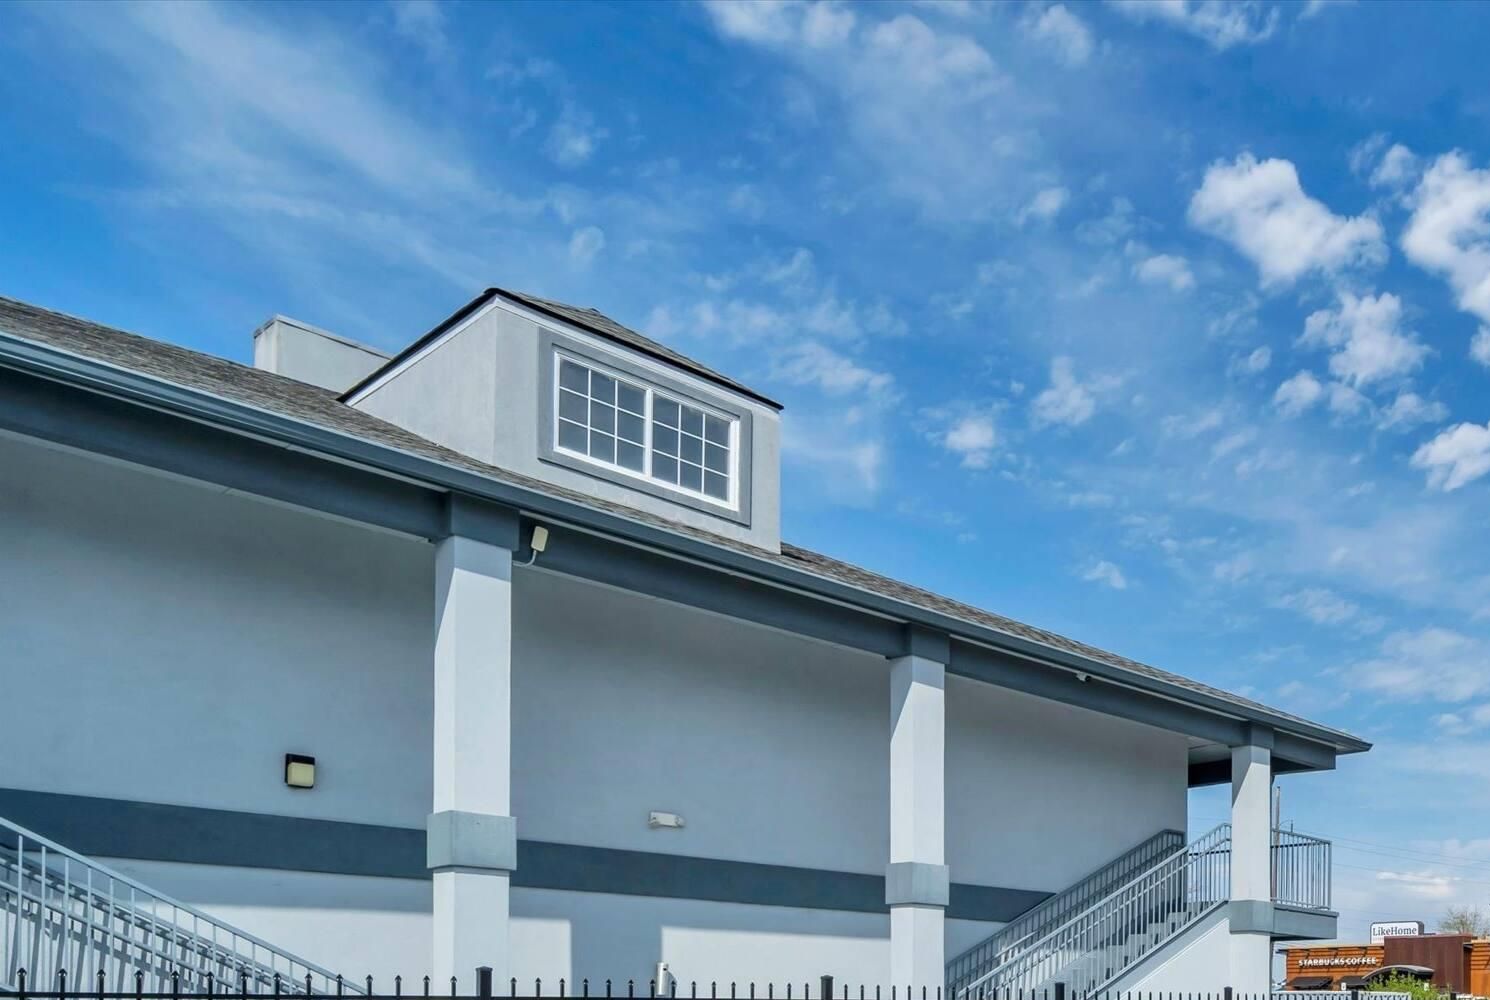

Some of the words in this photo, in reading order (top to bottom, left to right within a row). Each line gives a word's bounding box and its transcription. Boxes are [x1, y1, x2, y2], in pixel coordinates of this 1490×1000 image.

[1372, 926, 1417, 937] LikeHome
[1298, 957, 1345, 967] STARBUCKS
[1345, 956, 1377, 966] COFFEE
